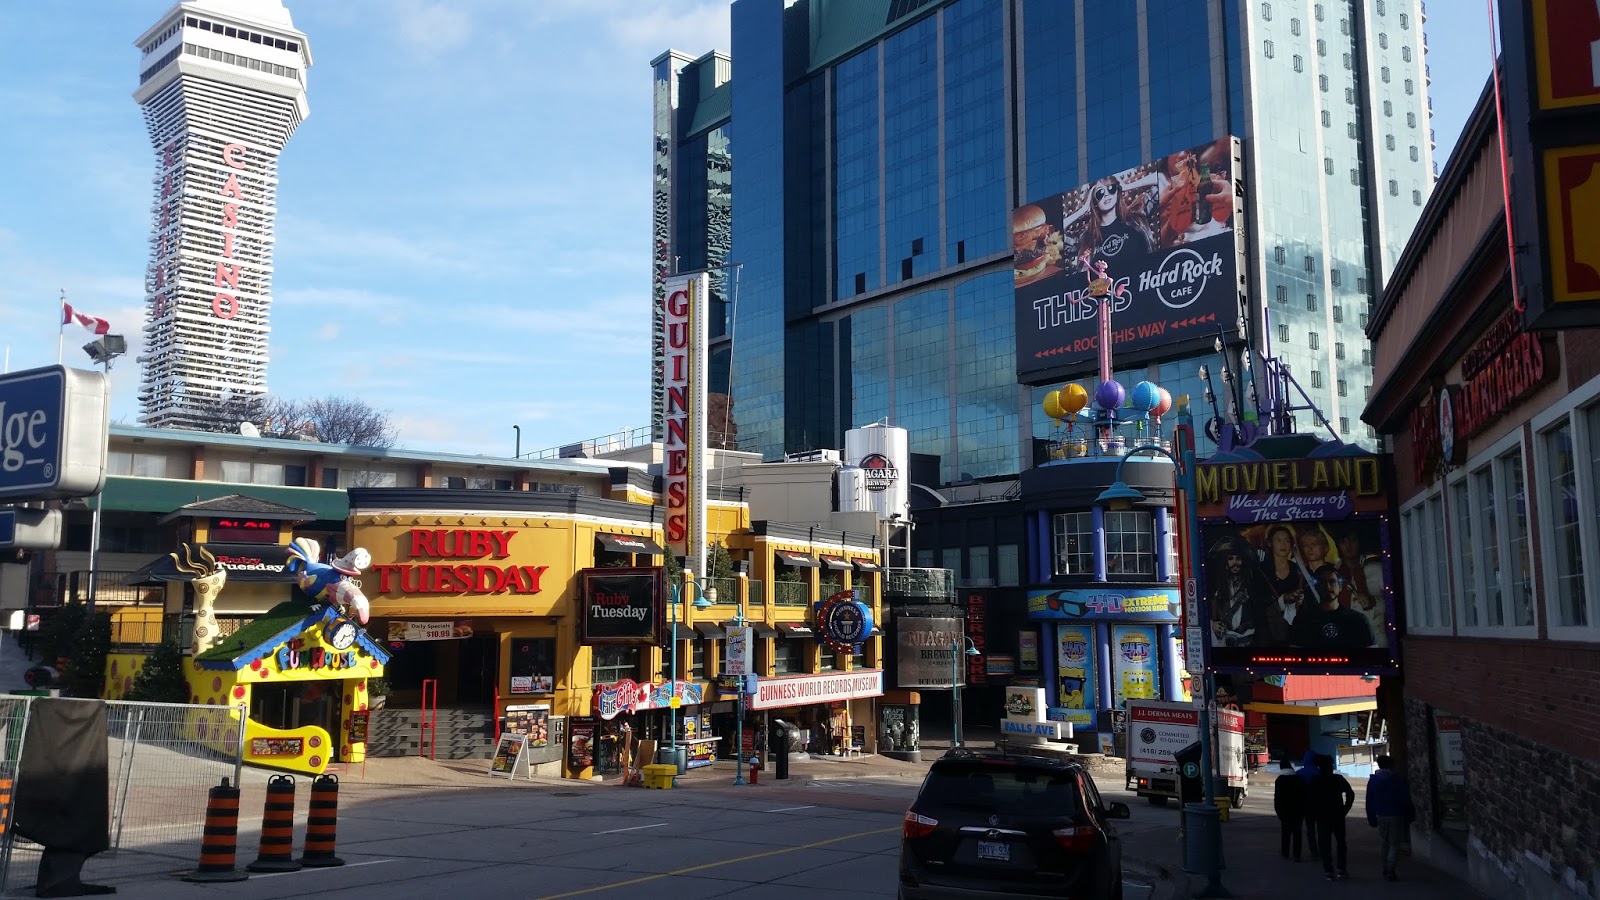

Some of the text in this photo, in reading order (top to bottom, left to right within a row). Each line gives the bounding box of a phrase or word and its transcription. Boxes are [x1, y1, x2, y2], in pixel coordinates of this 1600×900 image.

[212, 143, 247, 319] CASINO
[1112, 233, 1129, 247] Rock
[1138, 252, 1223, 292] Hard Rock
[1170, 286, 1193, 299] CAFE
[1033, 288, 1099, 330] THIS
[1073, 320, 1168, 353] ROC THIS WAY
[1455, 331, 1545, 440] HAMBURGERS
[666, 289, 689, 544] GUINNESS
[865, 468, 899, 479] AGARA
[1195, 457, 1380, 502] MOVIELAND
[1230, 489, 1347, 510] Wax Museum of
[1251, 507, 1324, 522] The Stars
[408, 529, 519, 558] RUBY
[214, 561, 286, 573] Tuesday
[217, 555, 262, 565] Ruby
[371, 564, 549, 593] TUESDAY
[595, 592, 629, 608] Ruby
[1123, 594, 1169, 606] EXTREME
[591, 604, 648, 621] Tuesday
[835, 605, 859, 617] GUINNESS
[1124, 603, 1169, 613] MOTION RIDE
[426, 630, 450, 638] $10.99
[427, 623, 450, 631] Specials
[833, 620, 862, 640] WORLD RECORDS
[278, 646, 358, 670] FUN HOUSE
[920, 650, 954, 659] BREWIN
[616, 681, 637, 709] Gifts
[760, 676, 878, 702] GUINNESS WORLD RECORDS MUSEUM
[602, 699, 616, 715] Falls
[1147, 710, 1171, 718] DERMA
[1171, 711, 1193, 720] MEATS
[1004, 722, 1054, 736] FALLS AVE
[1158, 731, 1190, 739] COMMITTED
[695, 744, 709, 757] BIG
[1140, 747, 1157, 755] (416)
